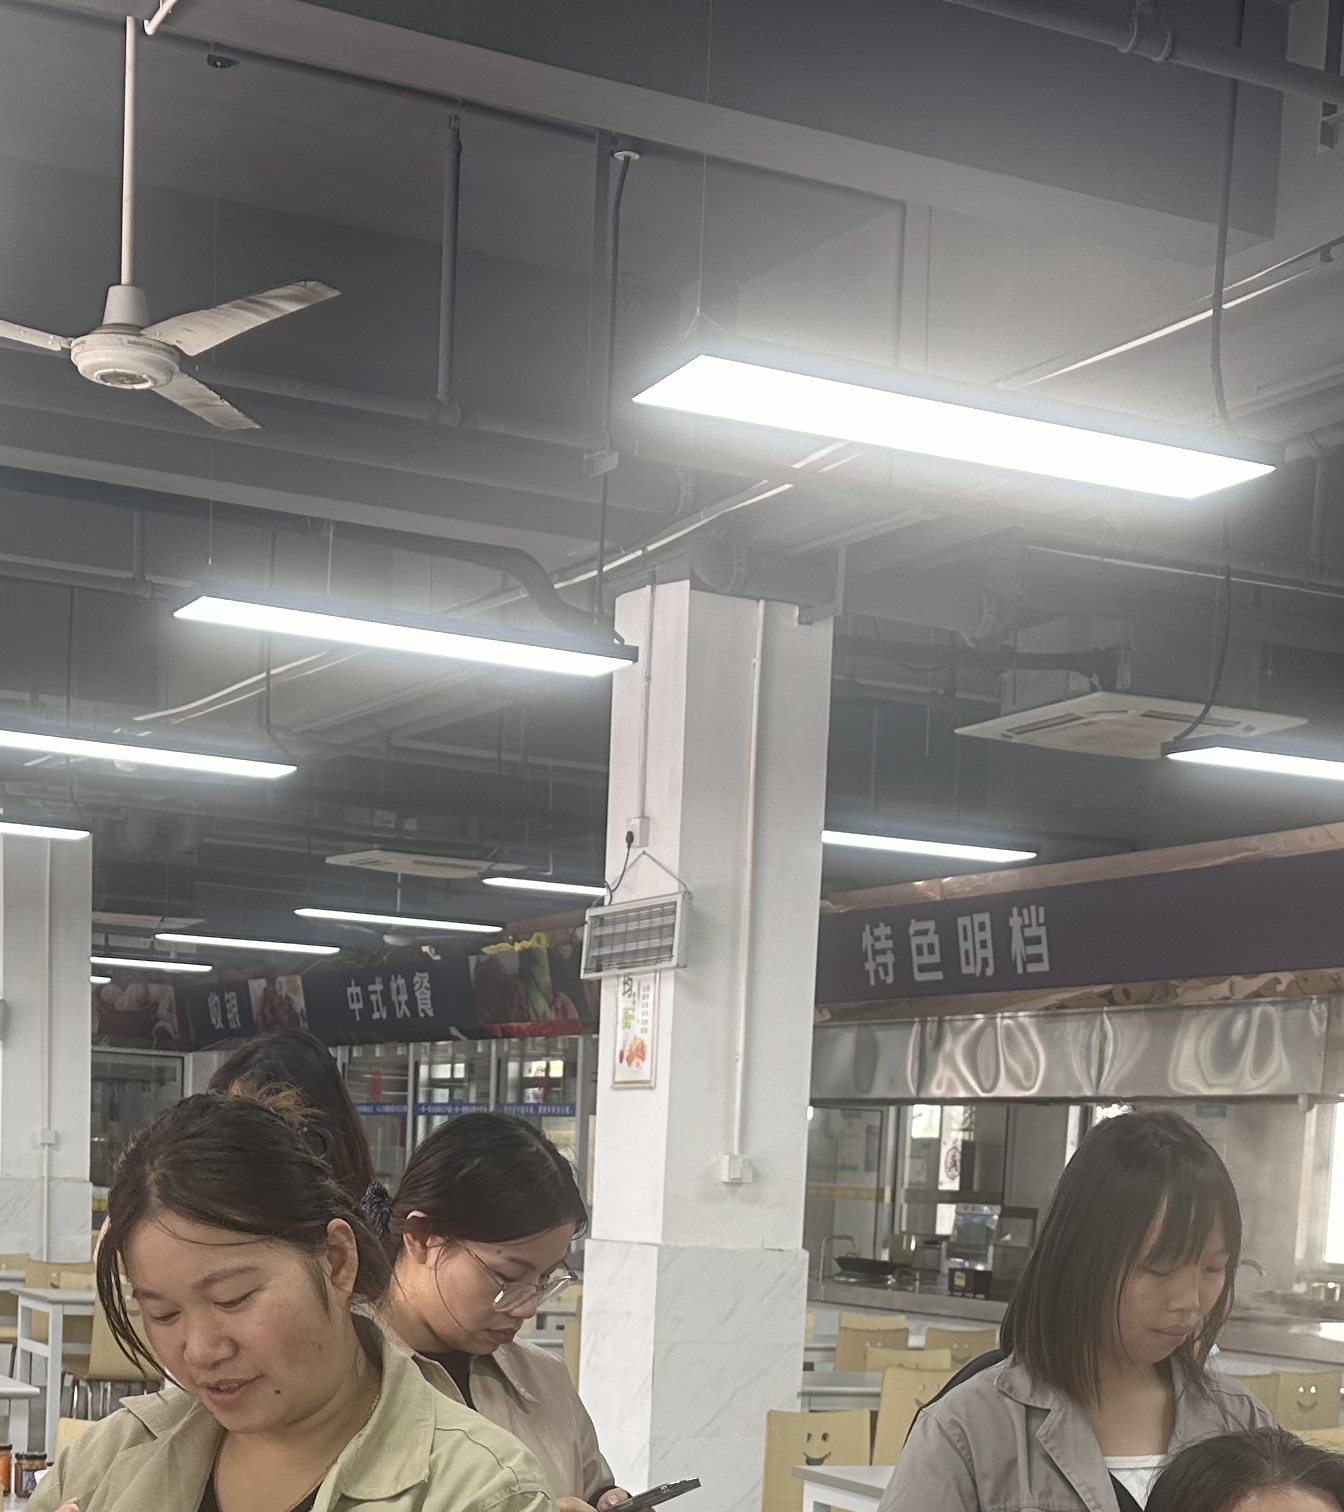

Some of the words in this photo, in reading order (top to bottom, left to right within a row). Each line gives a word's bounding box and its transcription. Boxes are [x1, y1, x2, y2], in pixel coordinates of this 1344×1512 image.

[862, 904, 1051, 987] 特色明档
[346, 970, 435, 1022] 中式快餐
